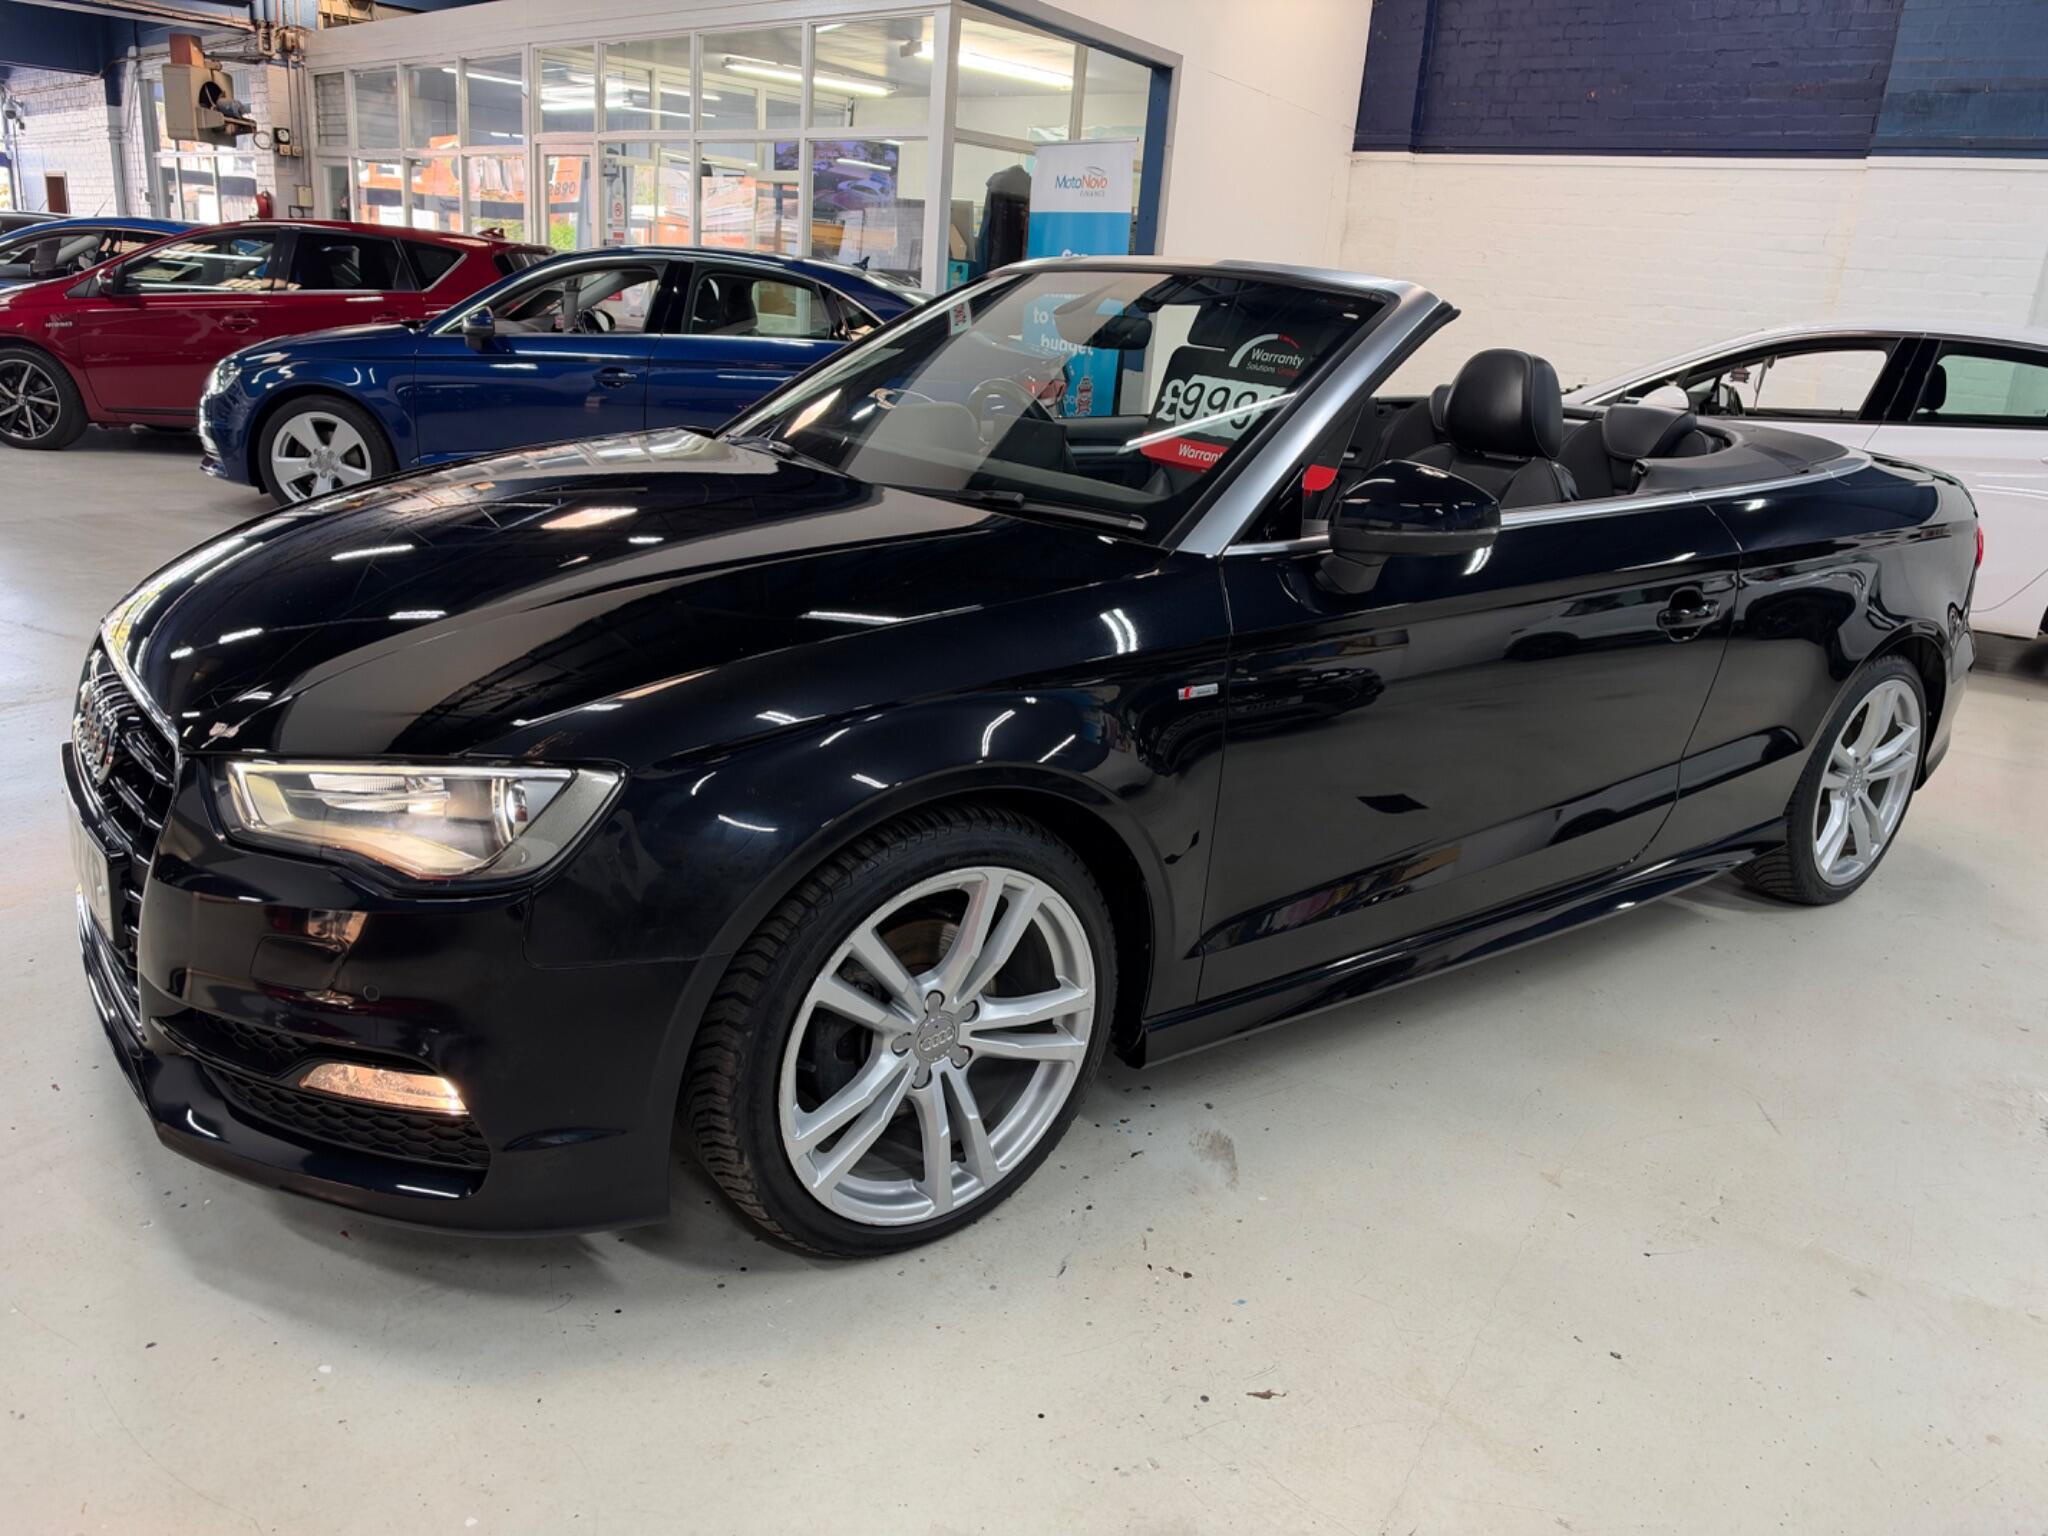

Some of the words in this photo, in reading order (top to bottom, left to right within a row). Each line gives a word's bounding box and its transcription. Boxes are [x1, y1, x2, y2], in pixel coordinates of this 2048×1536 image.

[1055, 174, 1108, 189] MotoNovo
[1033, 306, 1049, 324] to
[1251, 347, 1304, 369] Warranty
[1178, 443, 1223, 463] Warrant
